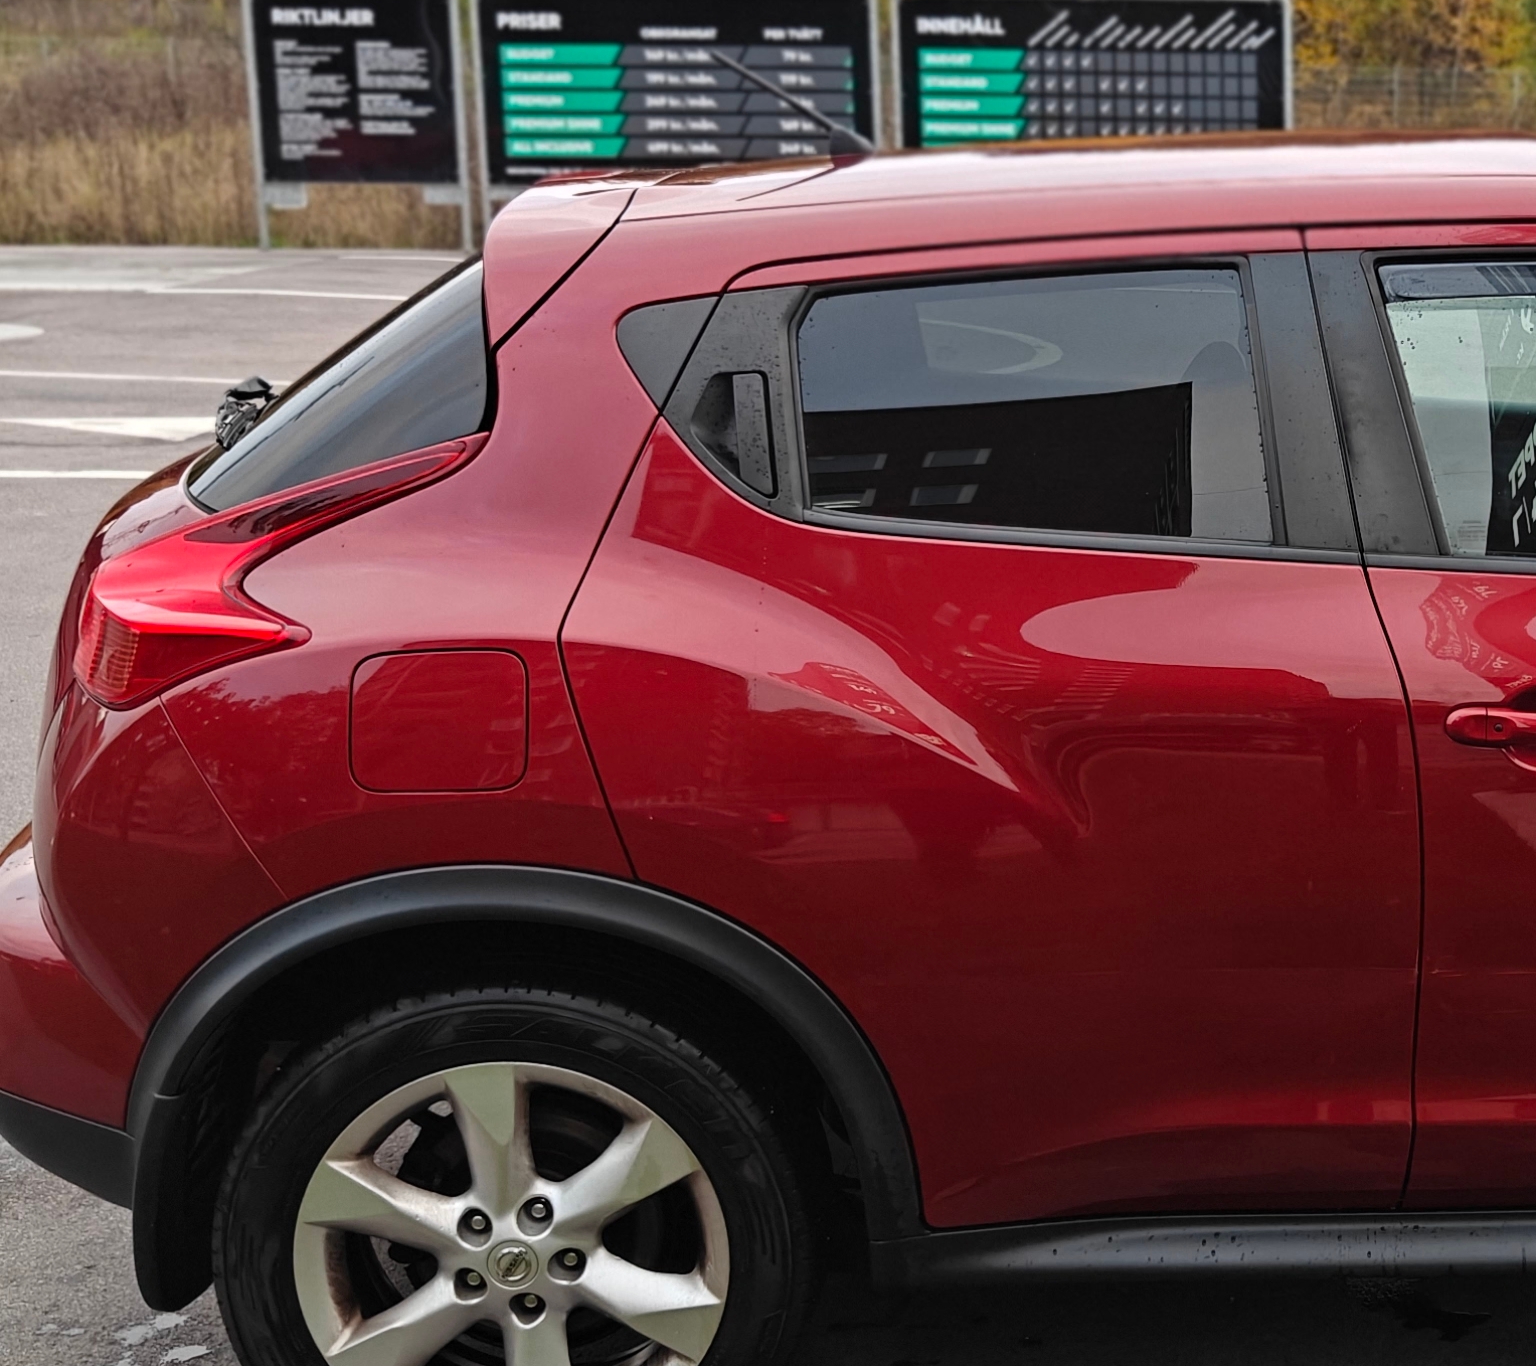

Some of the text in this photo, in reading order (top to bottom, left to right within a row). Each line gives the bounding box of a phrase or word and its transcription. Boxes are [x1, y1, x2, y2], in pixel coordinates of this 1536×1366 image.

[271, 8, 374, 26] RIKTLINJER
[496, 12, 562, 30] PRISER
[916, 14, 1006, 35] INNEHÅLL
